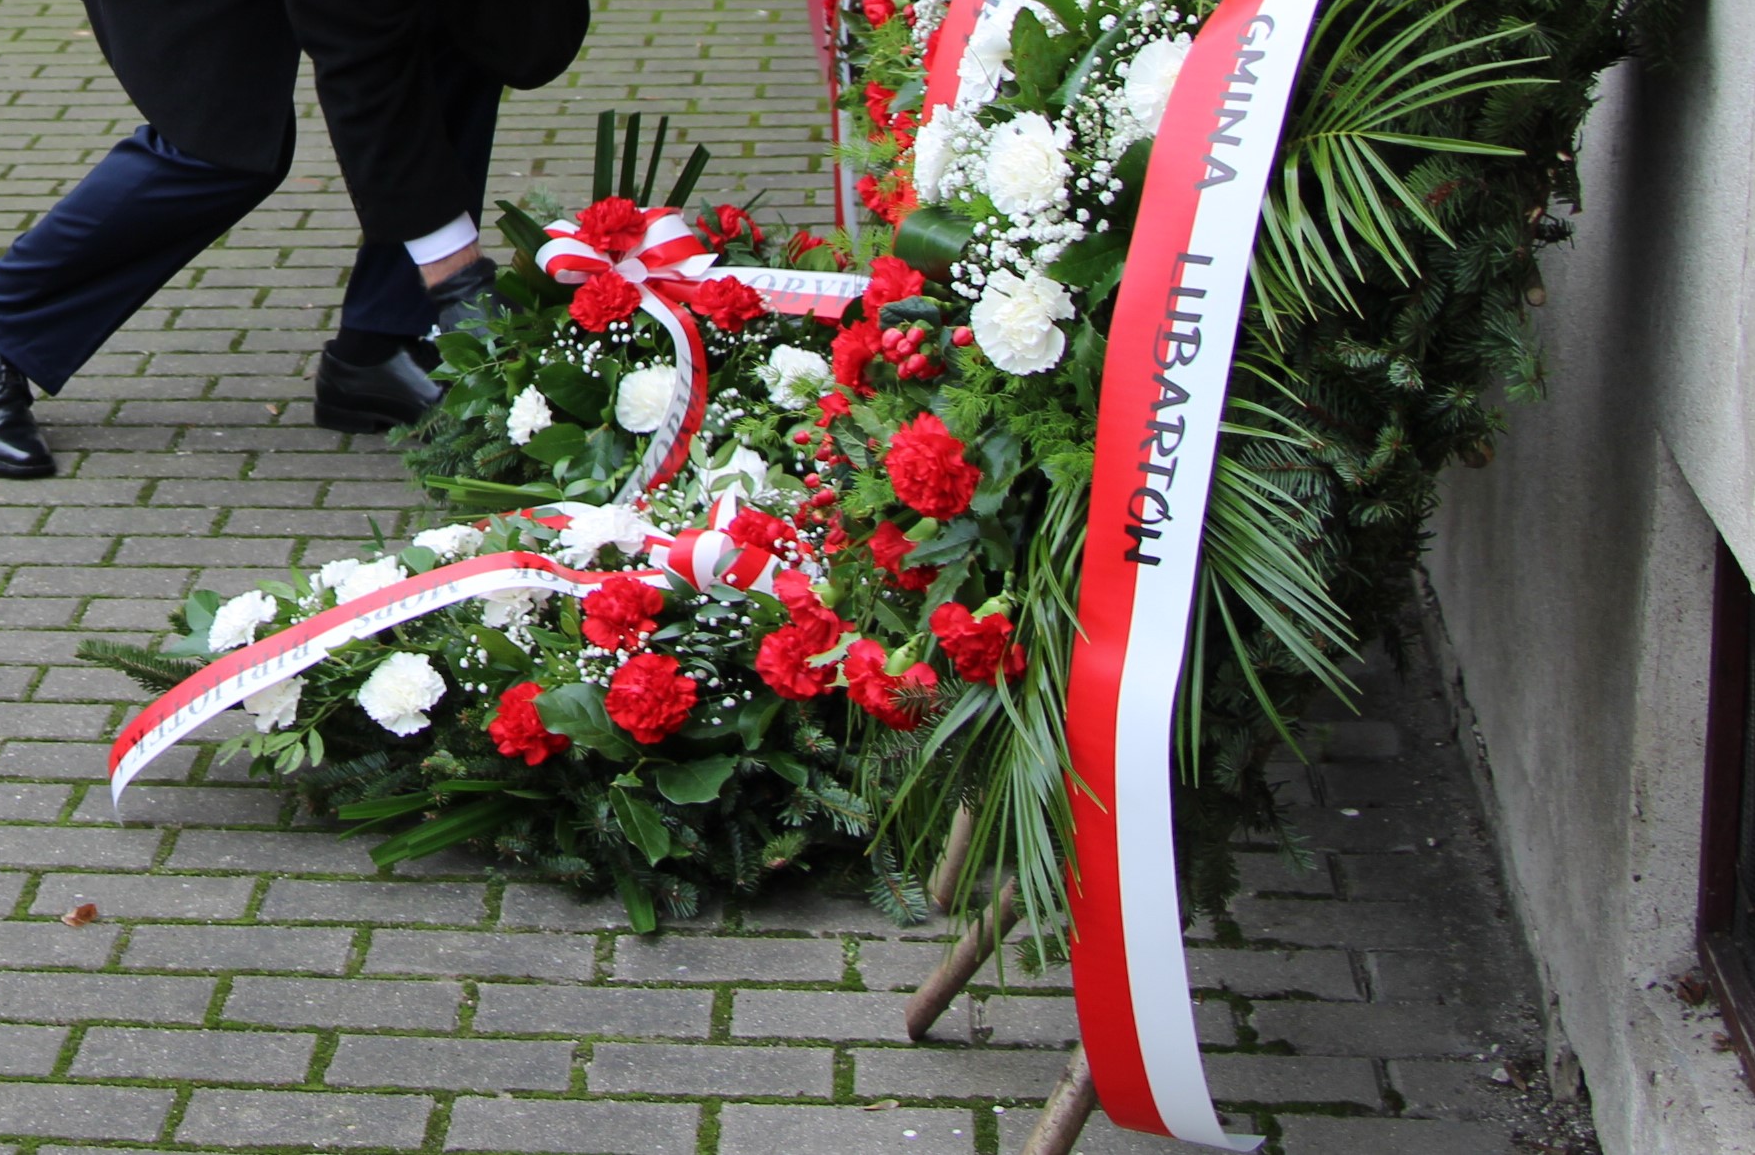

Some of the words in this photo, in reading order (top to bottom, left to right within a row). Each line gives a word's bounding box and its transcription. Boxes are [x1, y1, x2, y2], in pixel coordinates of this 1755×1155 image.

[1193, 13, 1276, 191] GMINA
[1123, 252, 1214, 567] LUBARTÓW
[352, 578, 459, 631] MOPS
[115, 632, 311, 775] BIBLIOTEKA
